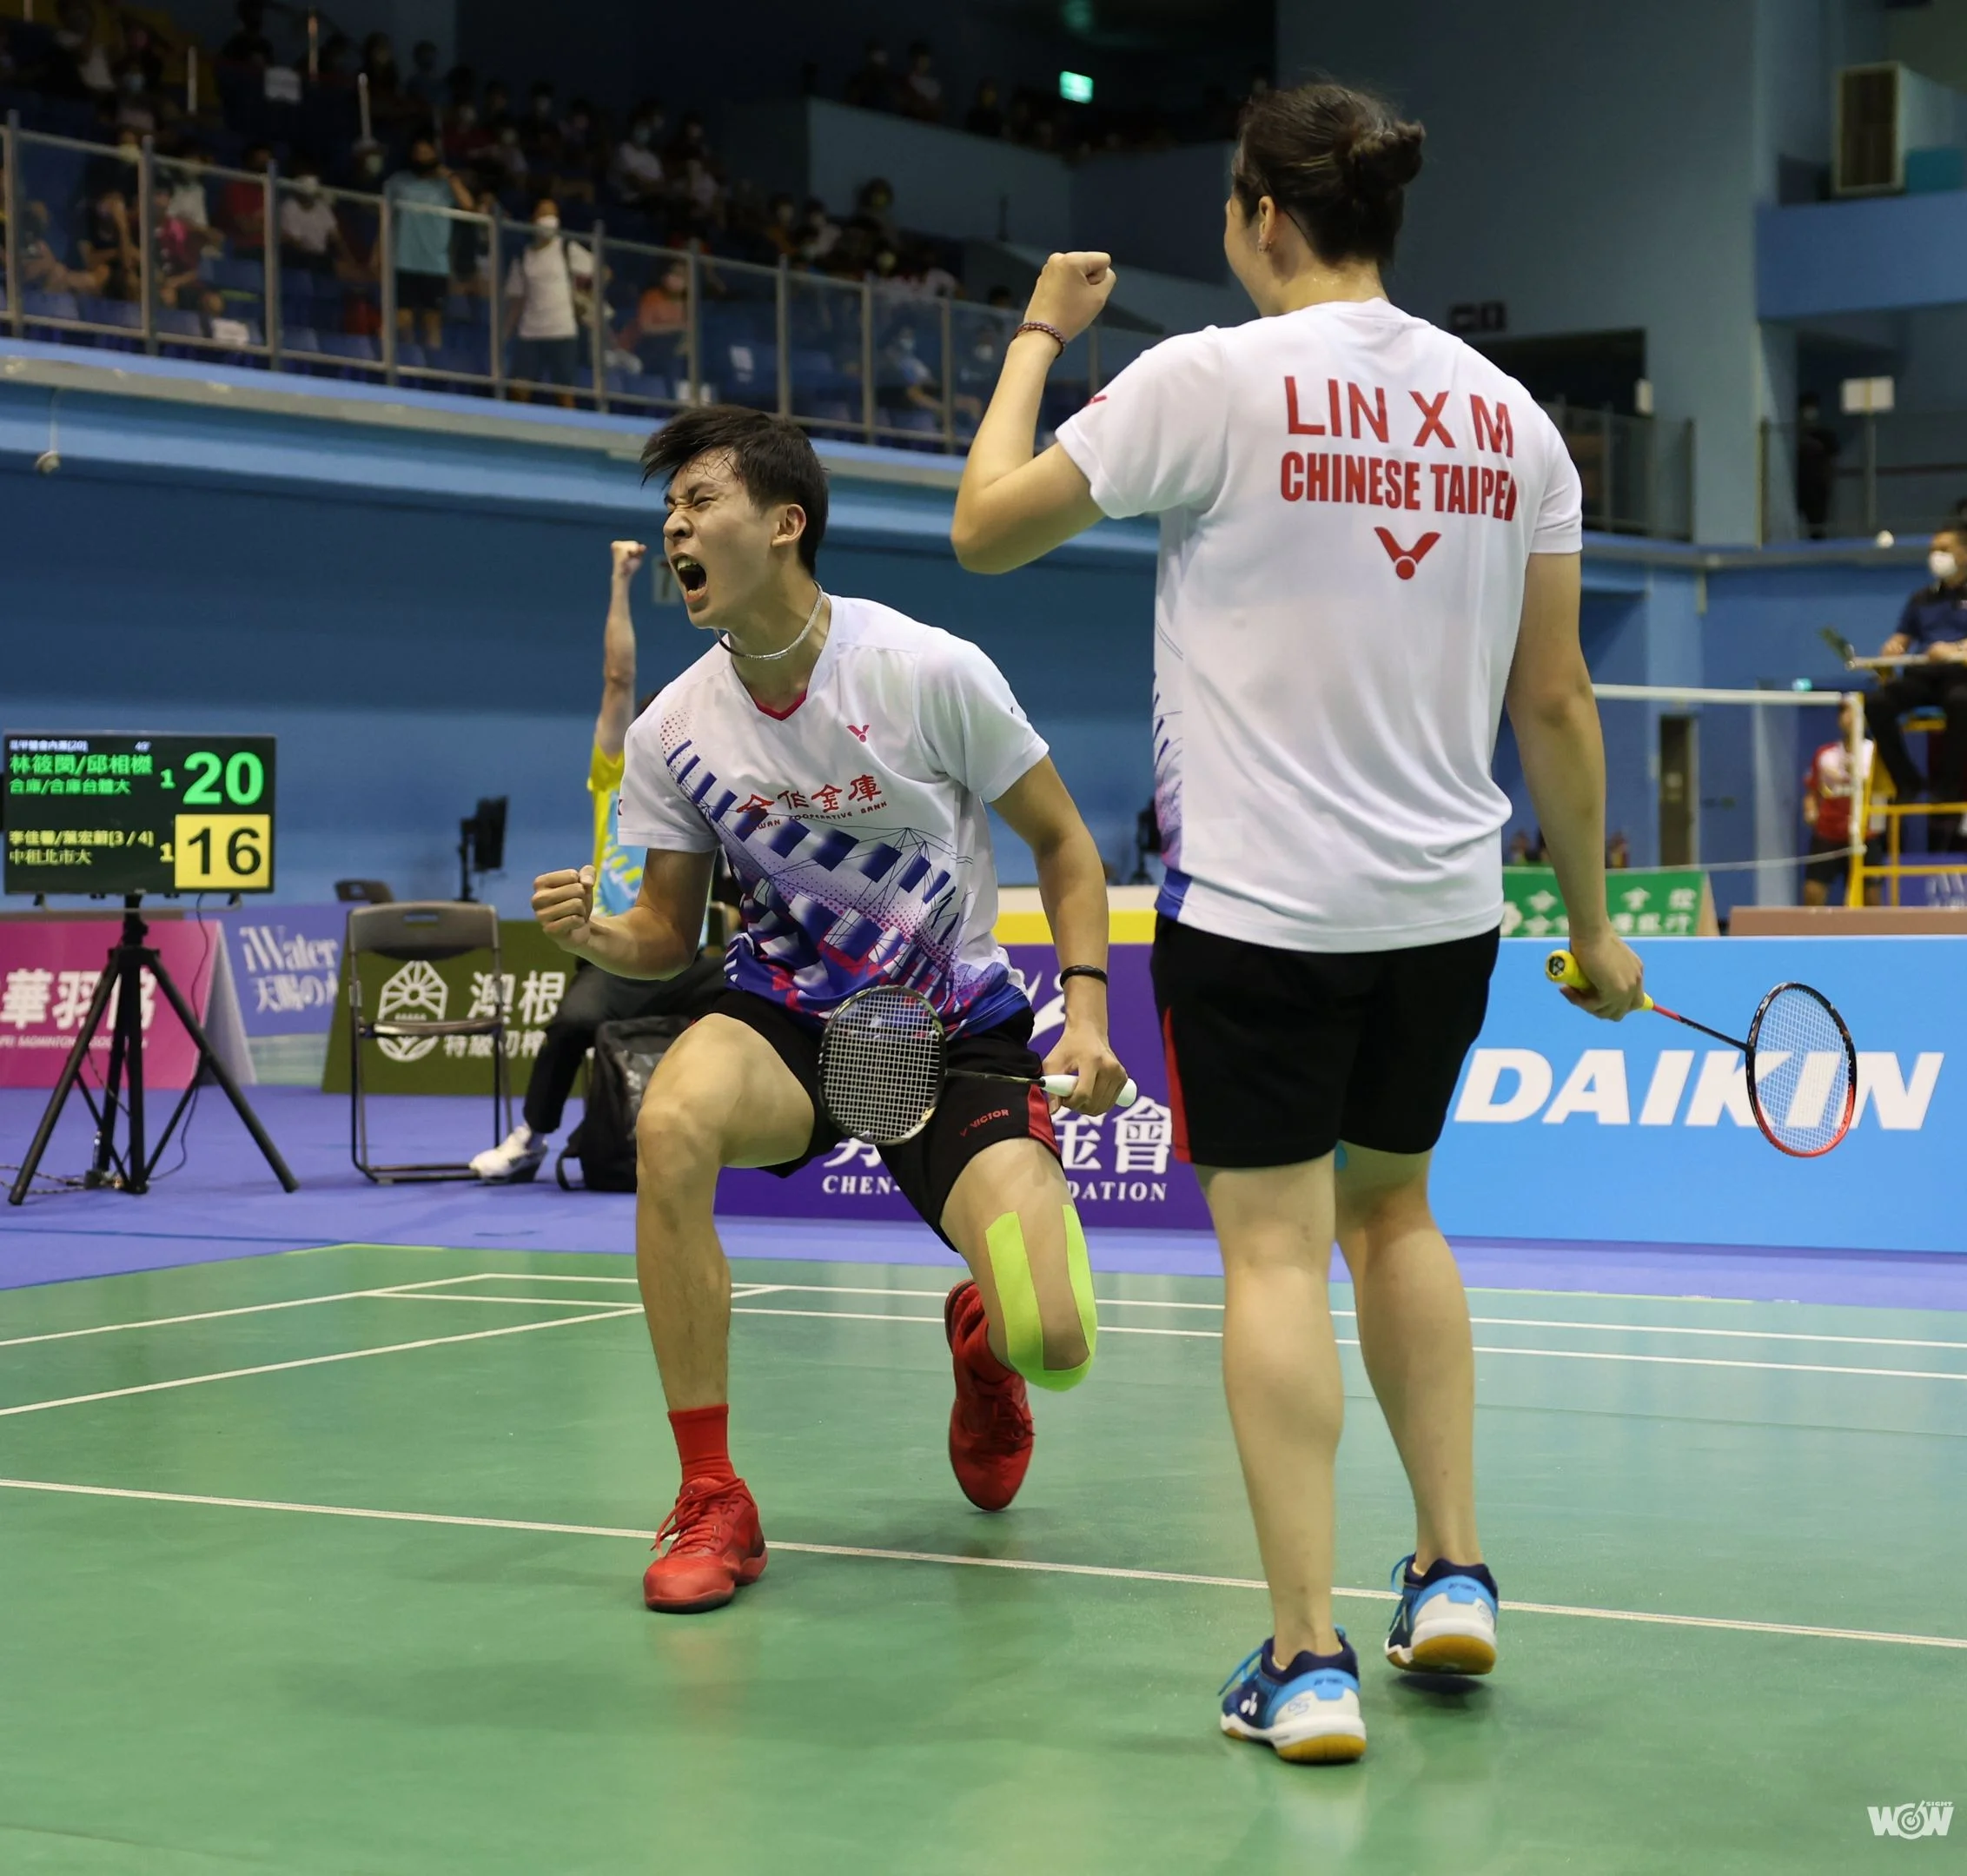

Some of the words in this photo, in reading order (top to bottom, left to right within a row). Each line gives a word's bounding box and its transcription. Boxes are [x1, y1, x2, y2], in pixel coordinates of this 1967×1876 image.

[1284, 375, 1389, 443] LIN
[1407, 390, 1457, 448] X
[1469, 394, 1514, 458] M
[1281, 451, 1421, 511] CHINESE
[1430, 463, 1518, 521] TAIPEI
[160, 768, 176, 789] 1
[182, 751, 264, 805] 20
[160, 842, 175, 863] 1
[188, 826, 262, 875] 16
[970, 1108, 1010, 1128] VICTOR
[1454, 1048, 1945, 1130] DAIKIN
